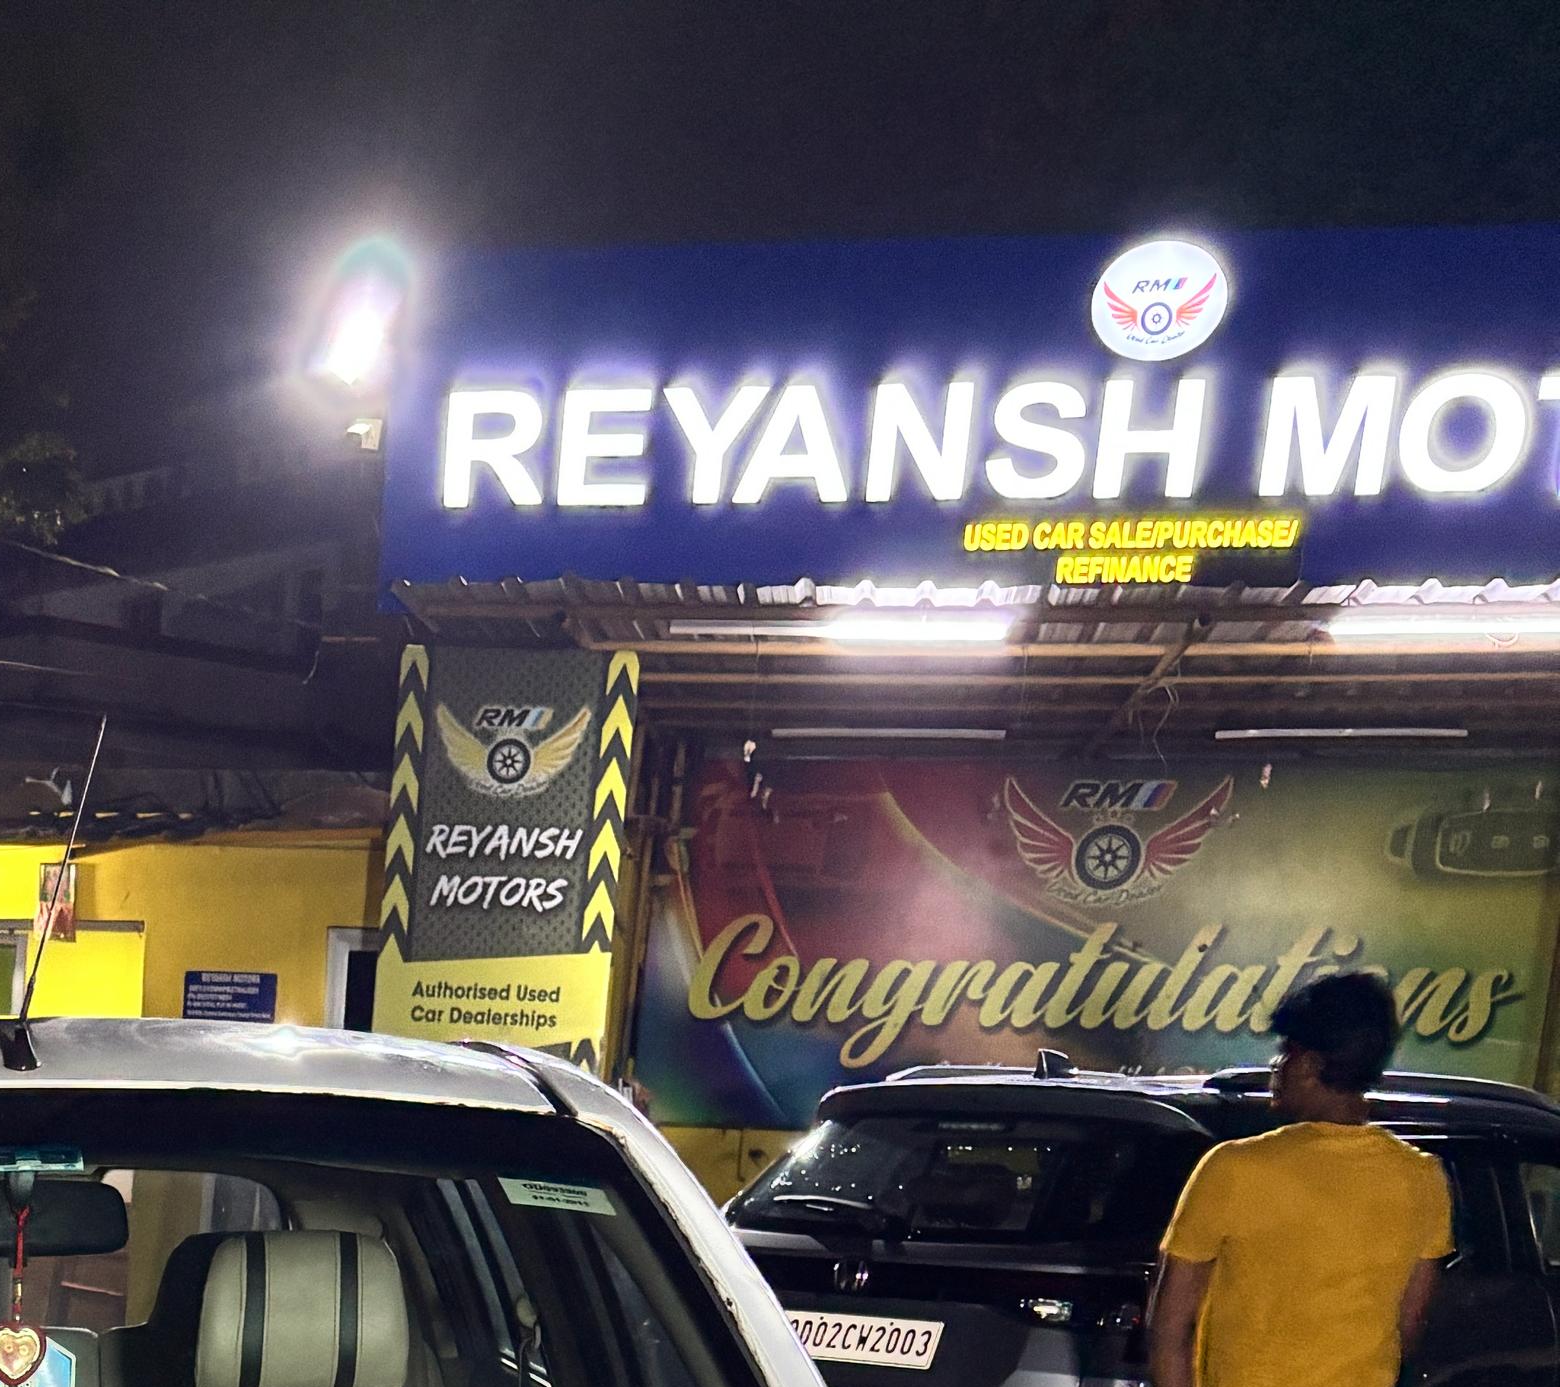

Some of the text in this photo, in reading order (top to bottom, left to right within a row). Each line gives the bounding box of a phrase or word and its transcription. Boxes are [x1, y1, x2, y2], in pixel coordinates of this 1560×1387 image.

[441, 373, 1560, 508] REYANSH MO
[963, 521, 1029, 551] USED
[1032, 521, 1085, 550] CAR
[1055, 555, 1193, 584] REFINANCE
[425, 823, 583, 861] REYANSH
[429, 874, 569, 913] MOTORS
[411, 980, 561, 1003] Authorised Used
[686, 913, 1524, 1068] Congratulatns
[410, 1004, 558, 1031] Car Dealerships
